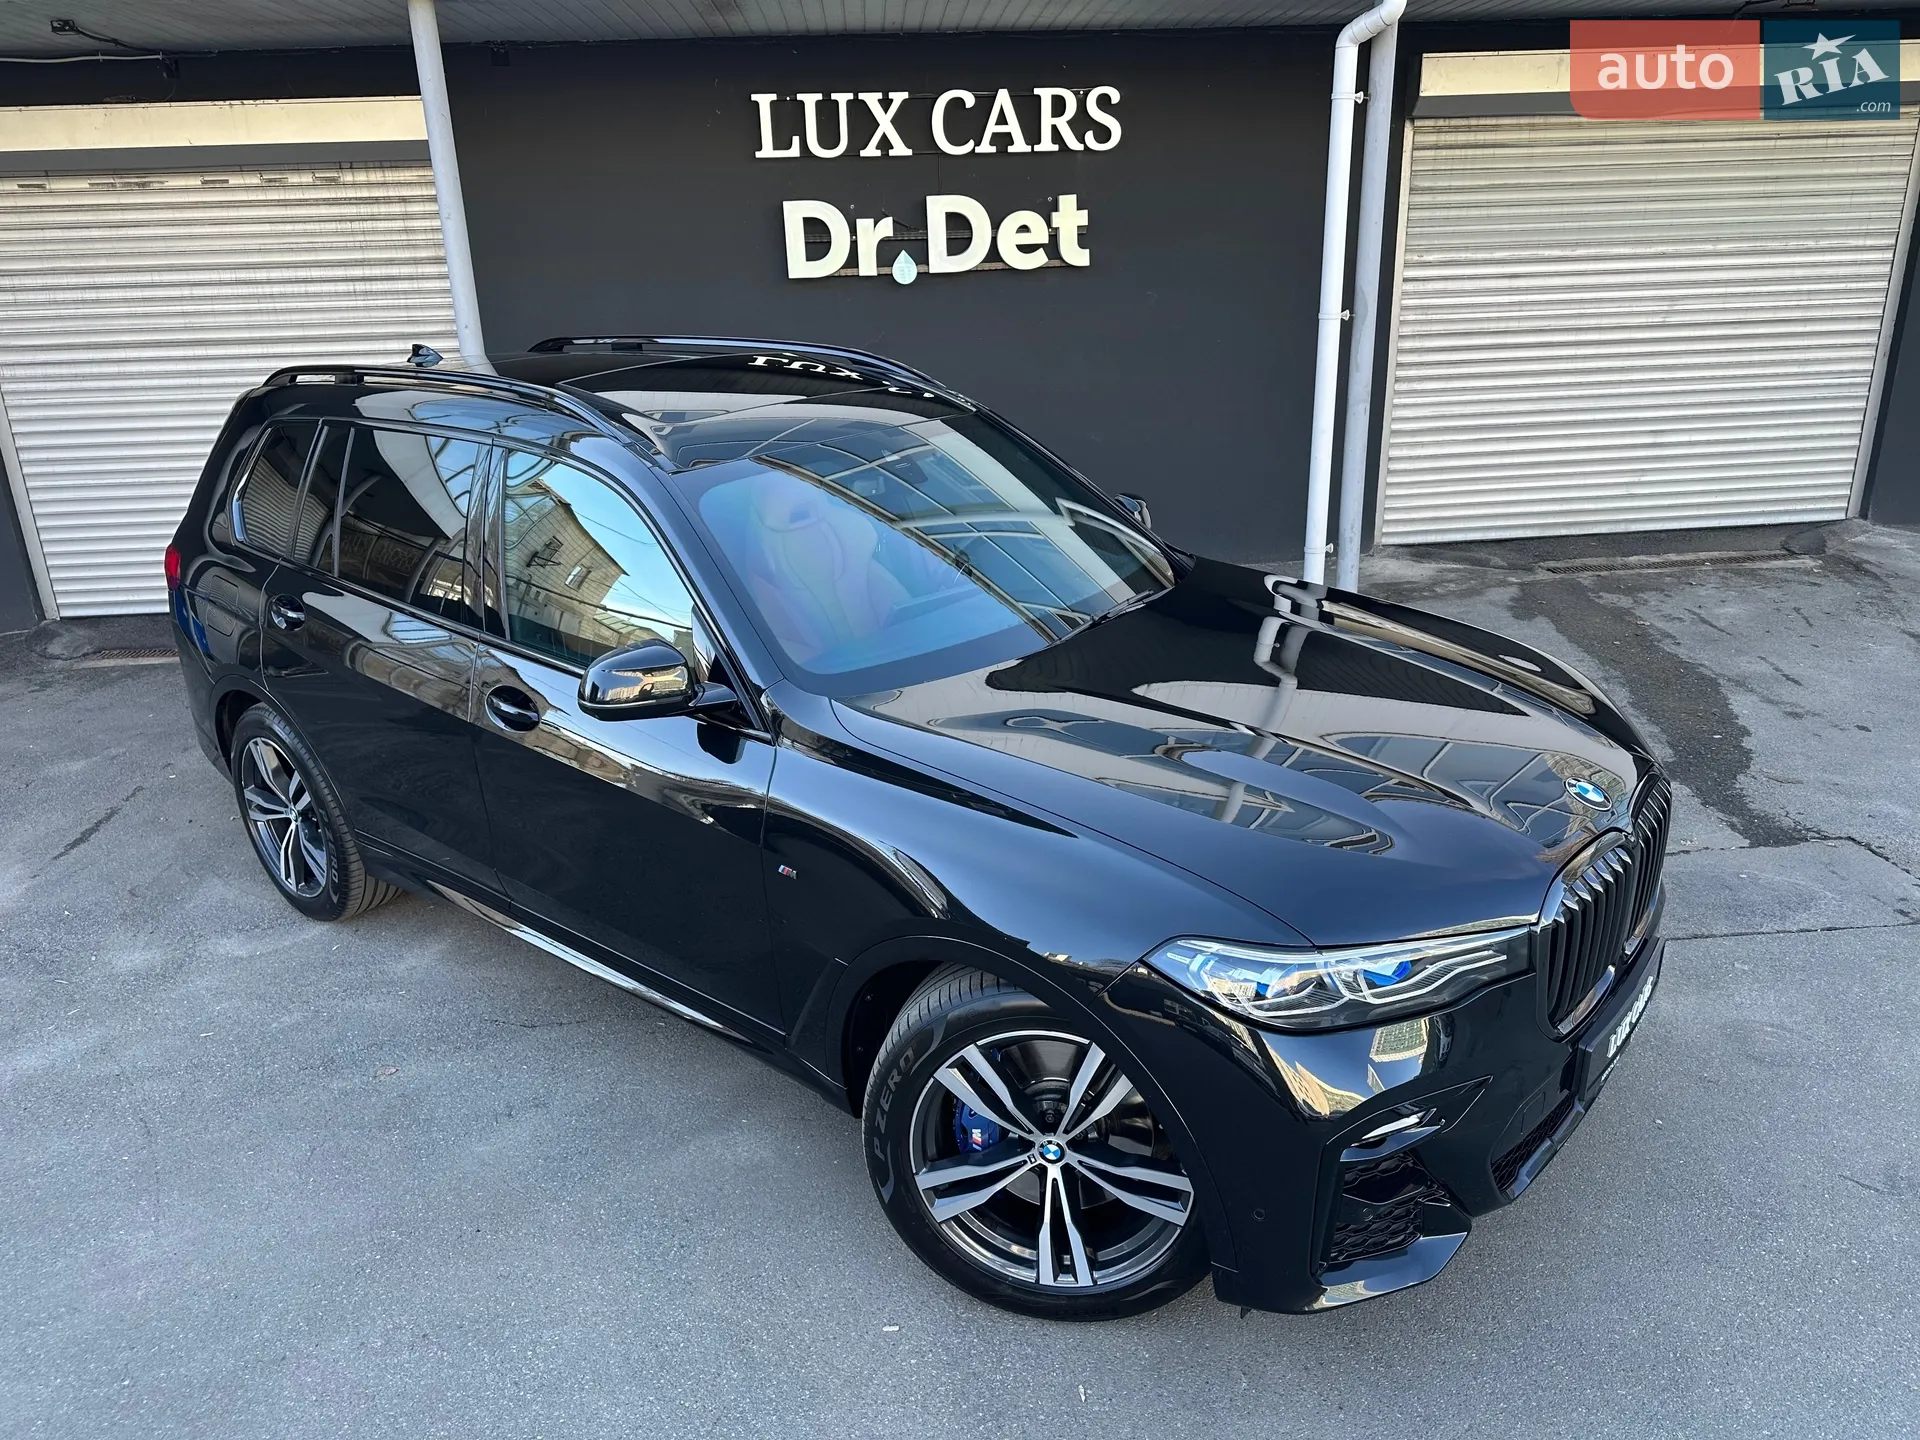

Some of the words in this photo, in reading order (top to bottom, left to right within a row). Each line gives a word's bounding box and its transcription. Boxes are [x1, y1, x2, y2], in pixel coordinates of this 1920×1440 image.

[750, 91, 913, 159] LUX
[931, 86, 1122, 156] CARS
[875, 1046, 916, 1134] ZERO
